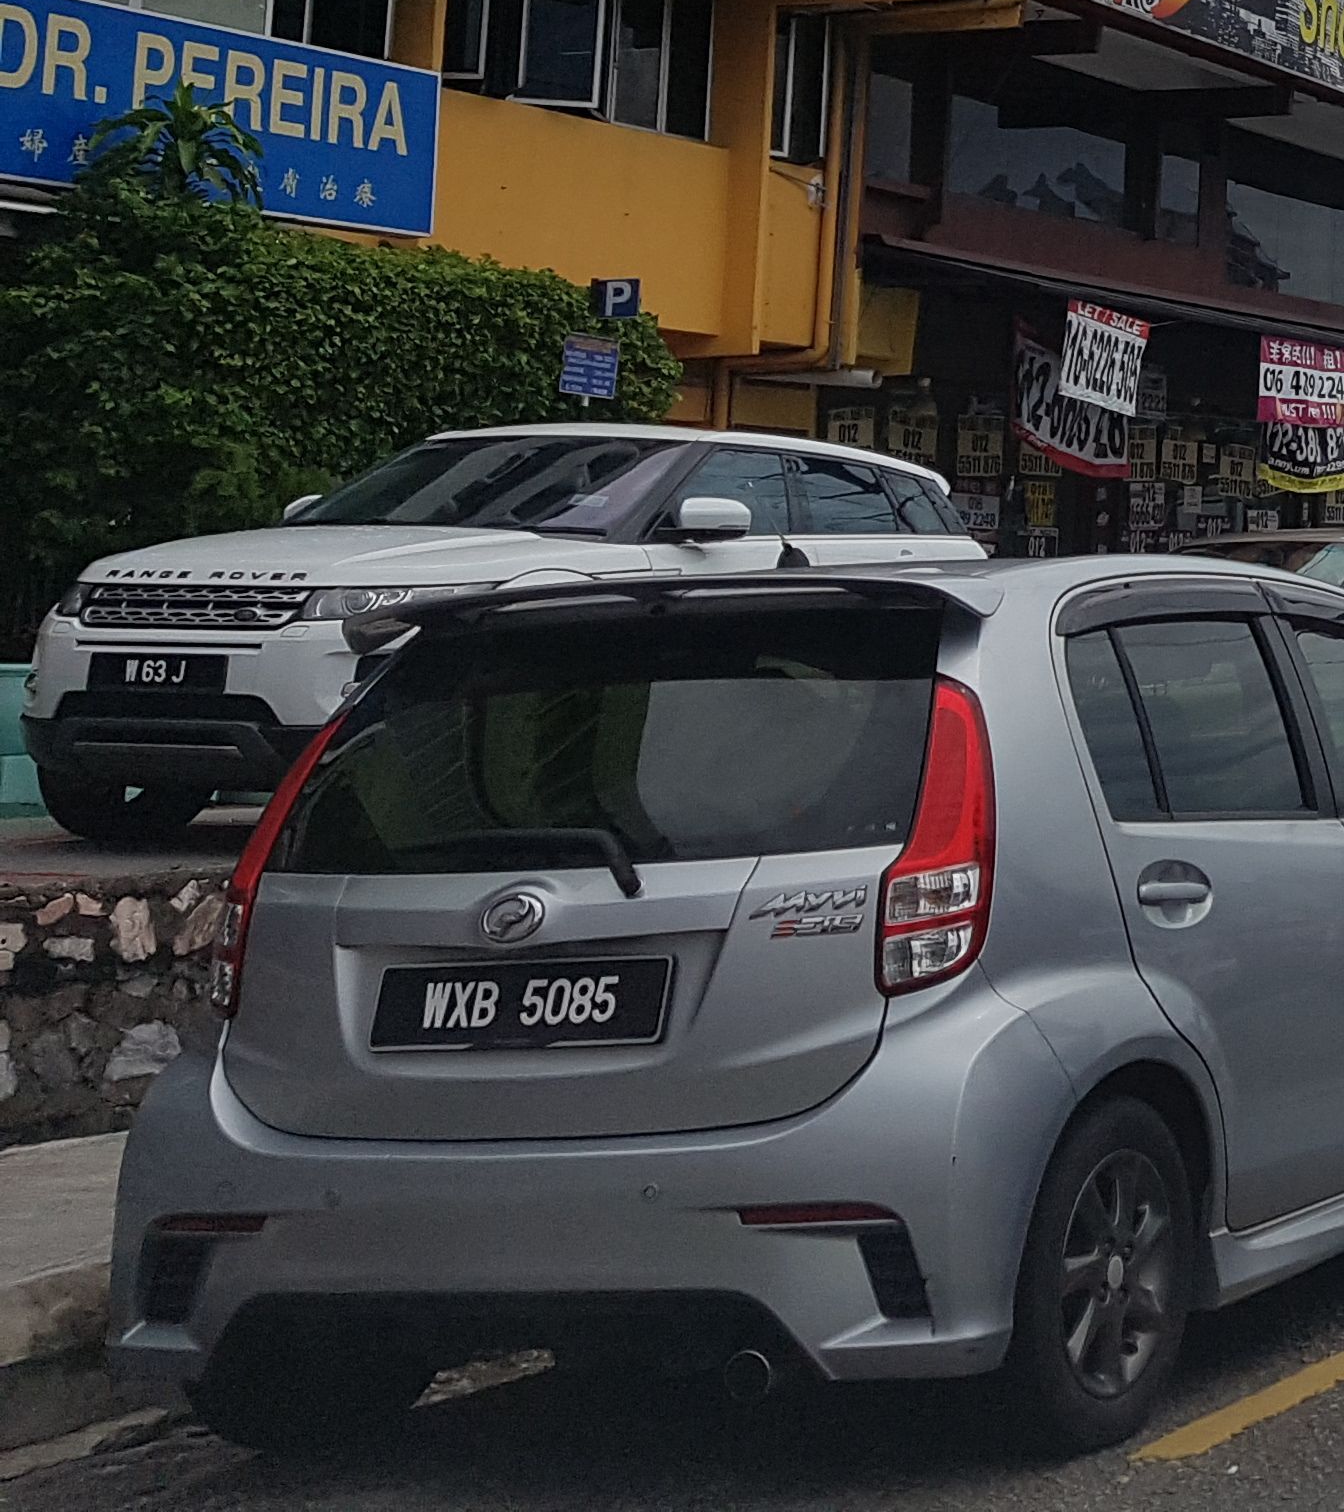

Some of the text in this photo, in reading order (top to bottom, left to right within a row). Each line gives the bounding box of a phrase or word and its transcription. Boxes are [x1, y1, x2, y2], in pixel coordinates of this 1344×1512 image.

[0, 3, 410, 157] DR. PEREIRA
[605, 280, 632, 317] P
[1077, 301, 1101, 321] LET
[1110, 312, 1143, 336] SALE
[838, 423, 859, 443] 012
[105, 569, 308, 581] RANGE ROVER
[125, 659, 186, 683] W 63 J
[422, 975, 620, 1030] WXB 5085
